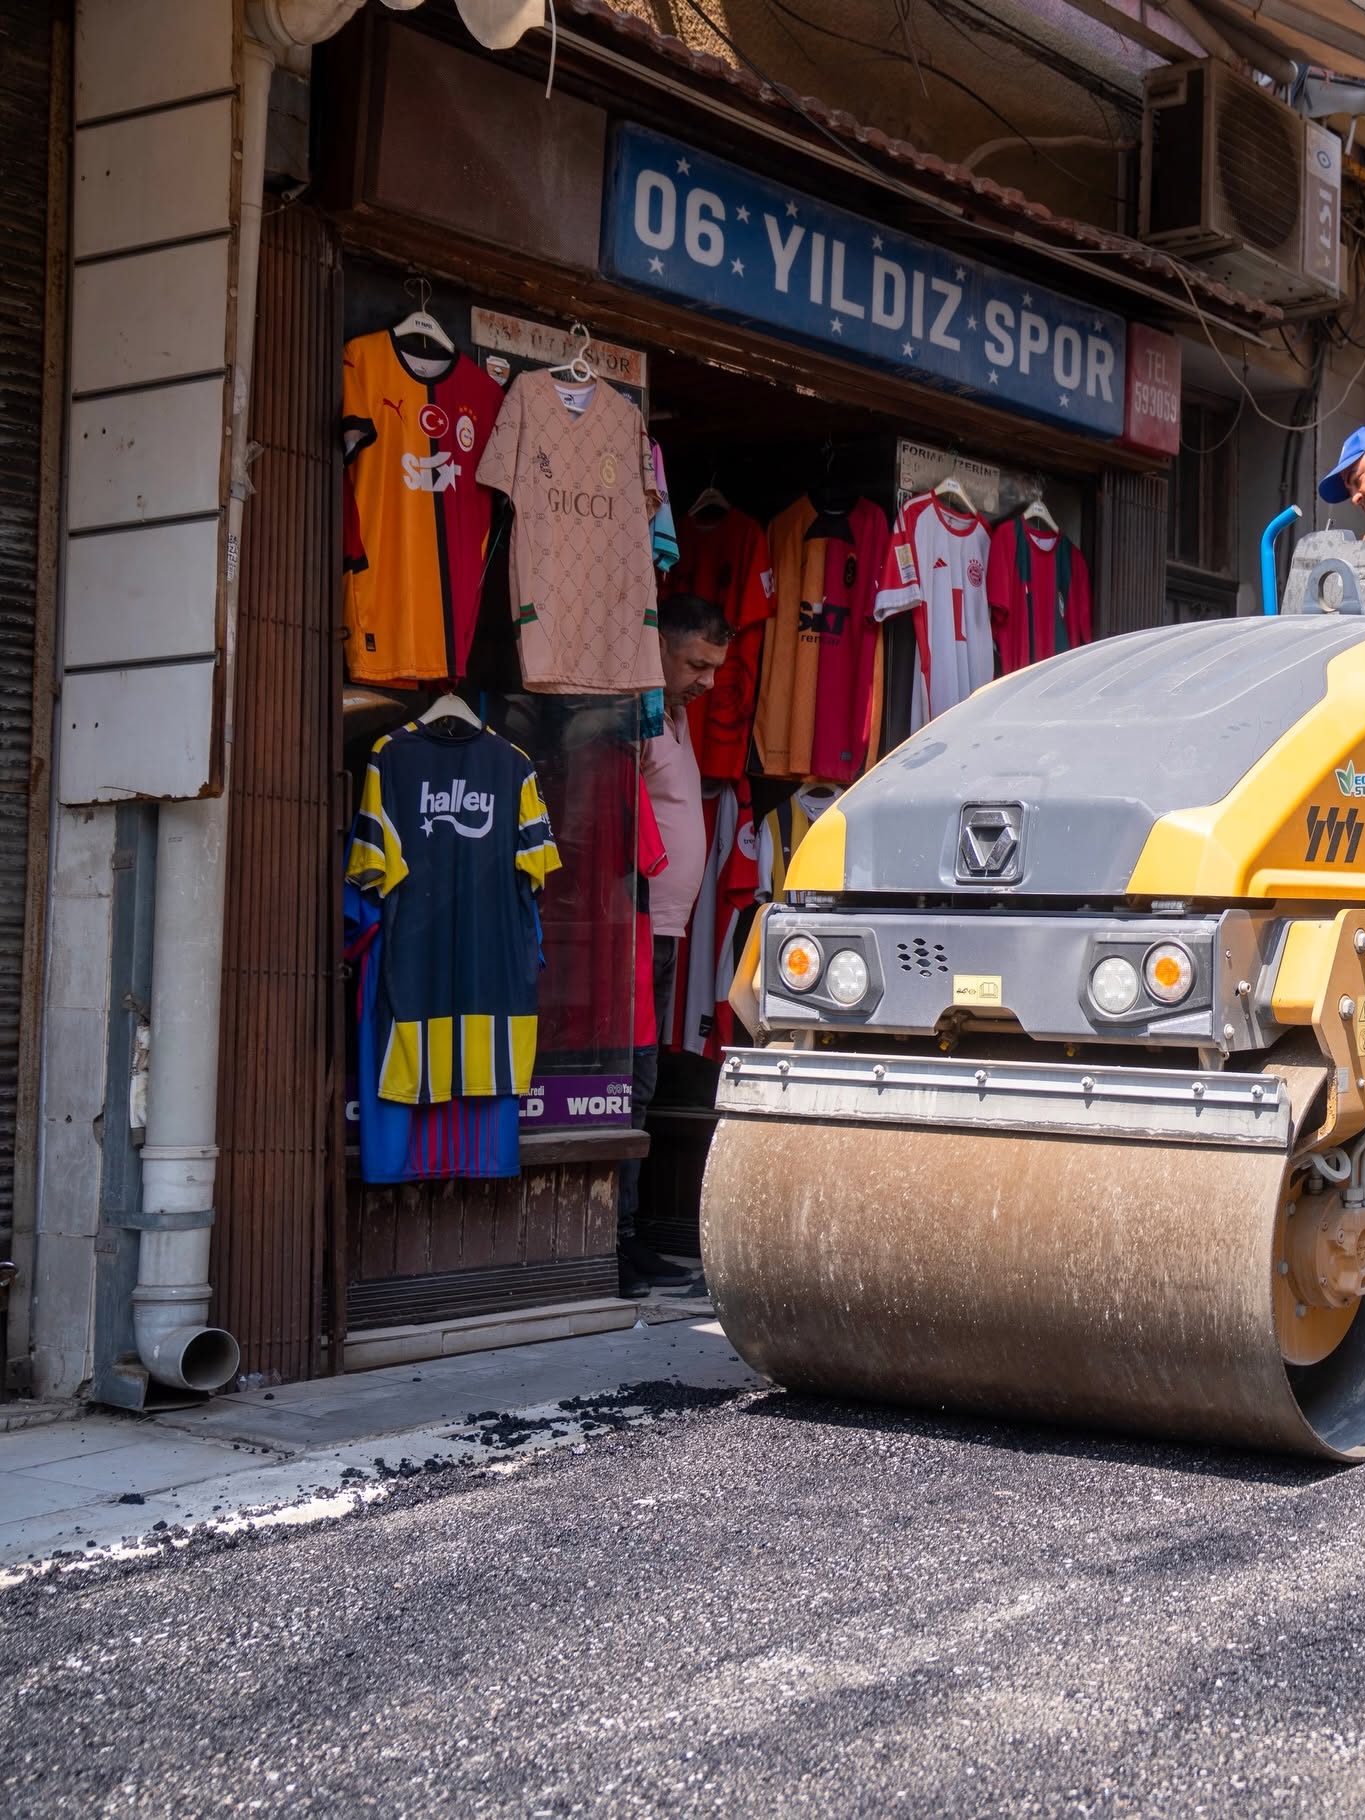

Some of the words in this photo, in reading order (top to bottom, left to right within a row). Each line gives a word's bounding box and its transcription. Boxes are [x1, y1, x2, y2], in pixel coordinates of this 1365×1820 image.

[633, 167, 727, 268] 06
[764, 211, 964, 353] YILDIZ
[983, 299, 1115, 404] SPOR
[1146, 348, 1169, 385] TEL
[1134, 380, 1178, 424] 593059
[548, 487, 614, 521] GUCCI
[419, 778, 495, 839] halley
